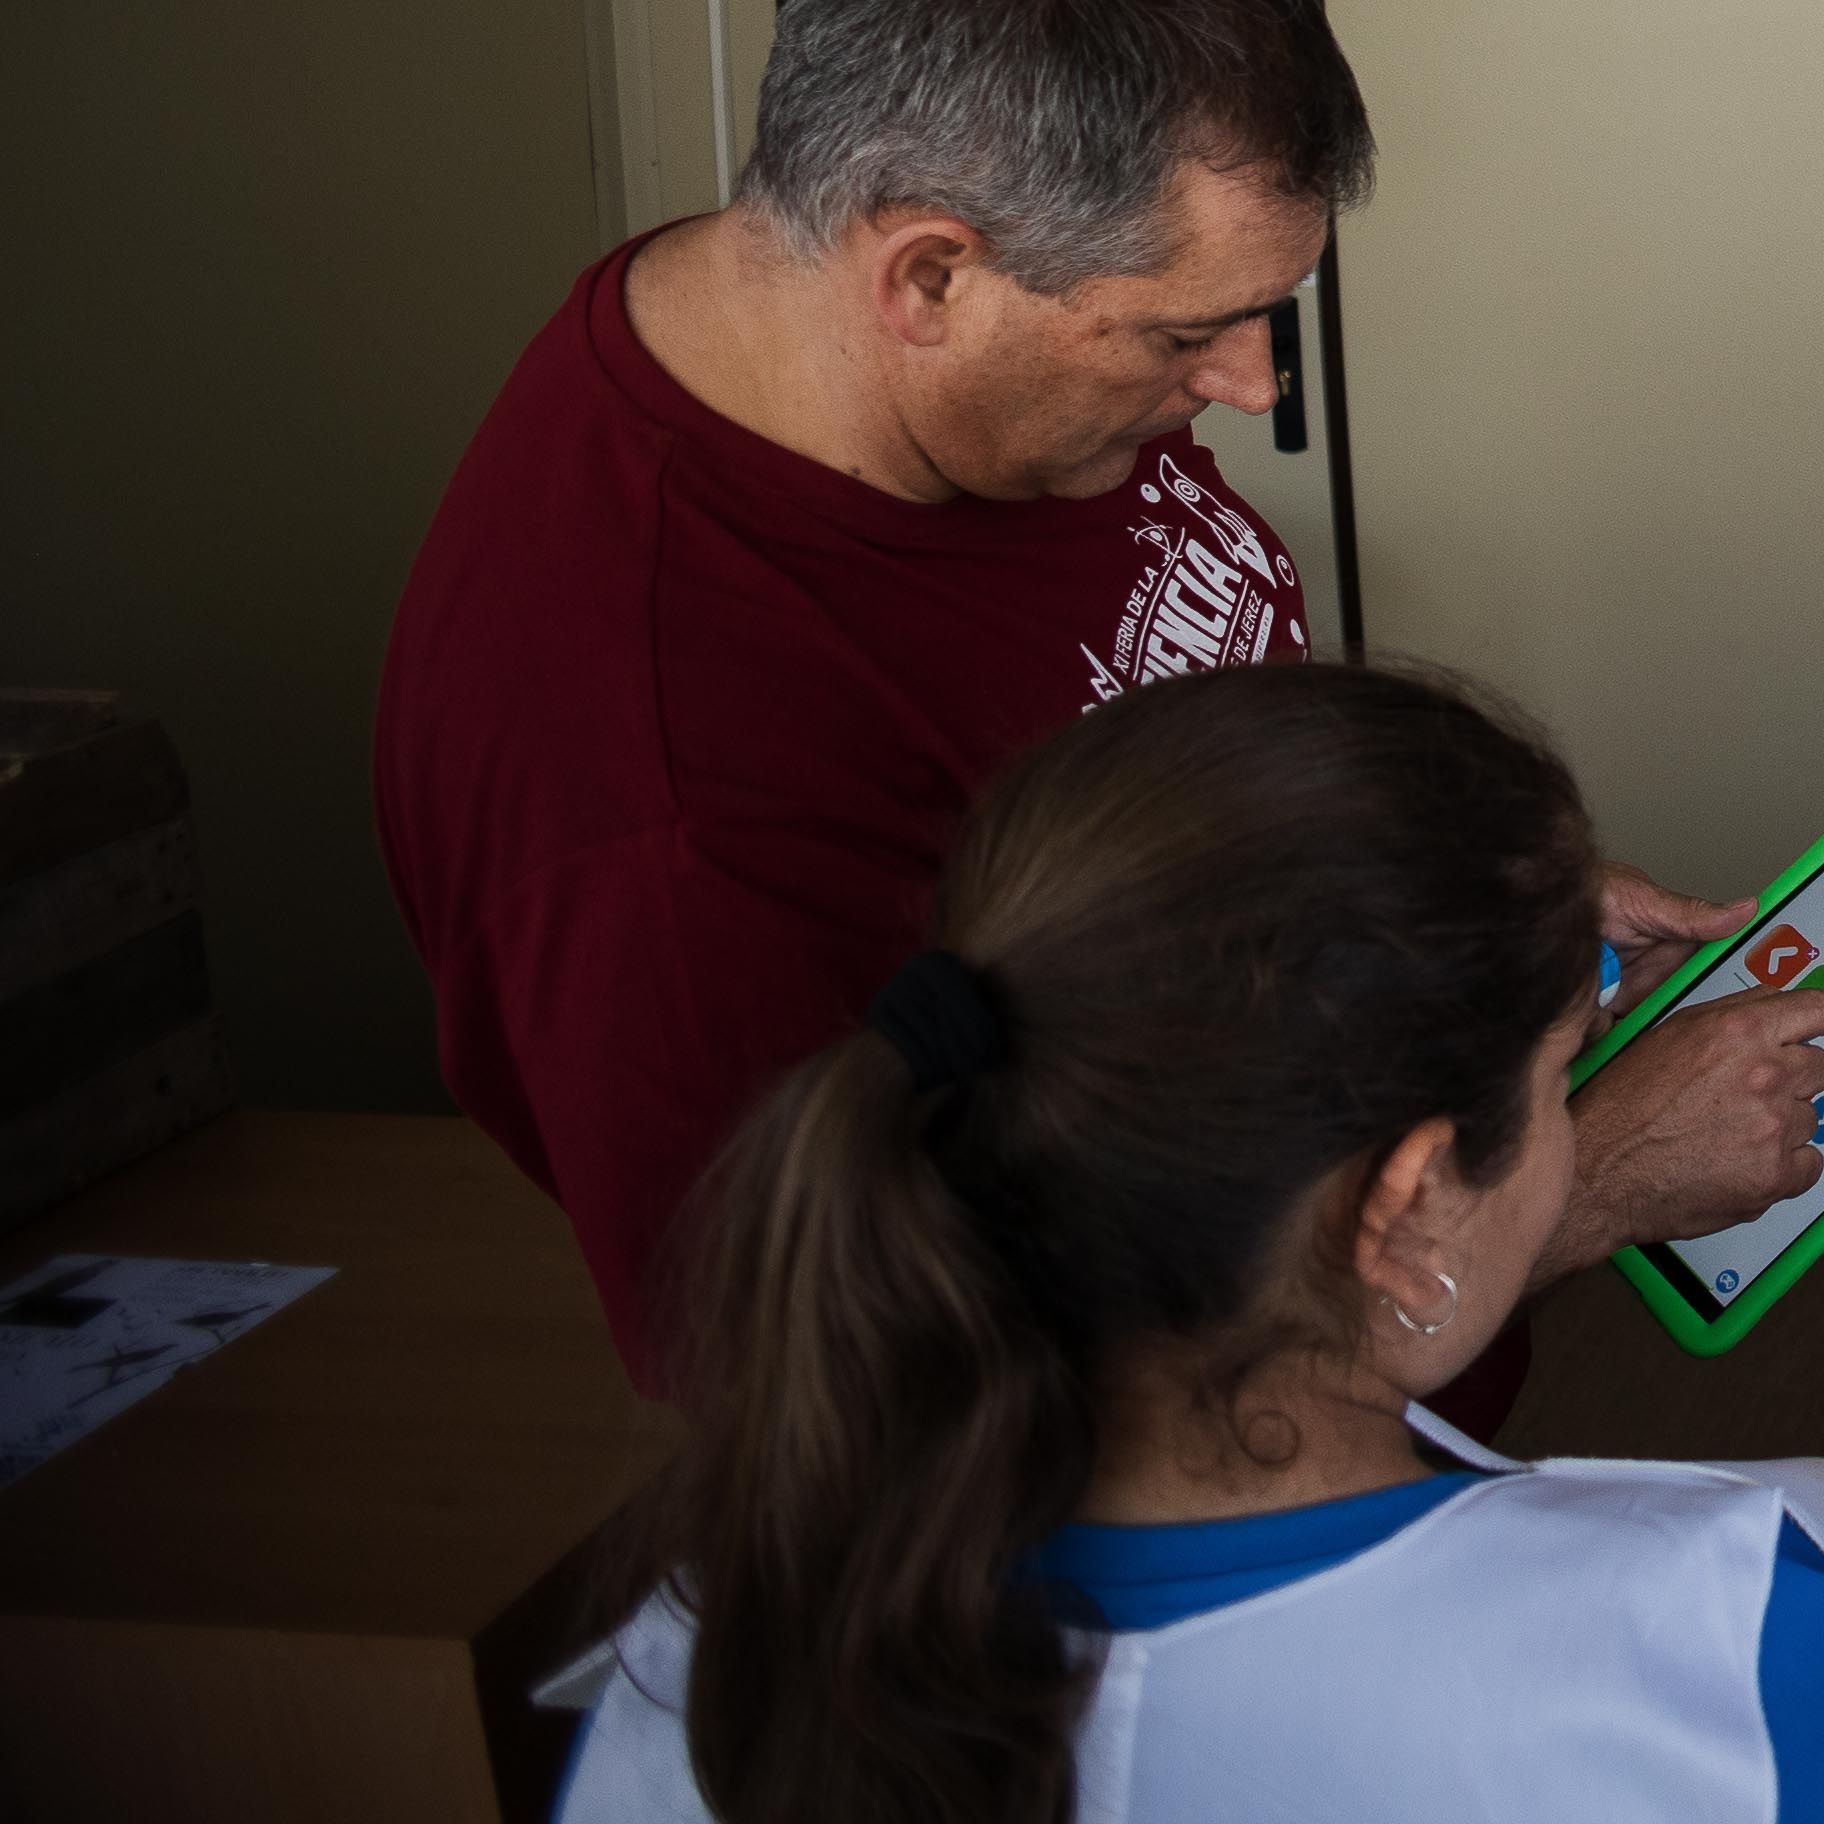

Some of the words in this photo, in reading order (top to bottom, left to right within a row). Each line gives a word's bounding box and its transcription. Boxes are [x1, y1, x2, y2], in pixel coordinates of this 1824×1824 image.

[1137, 566, 1159, 593] LA
[1126, 588, 1147, 617] DE
[1140, 538, 1243, 684] IENCIA
[1240, 589, 1263, 640] JEREZ
[1115, 615, 1139, 658] FERIA
[1233, 636, 1250, 662] DE
[1112, 653, 1130, 675] XI
